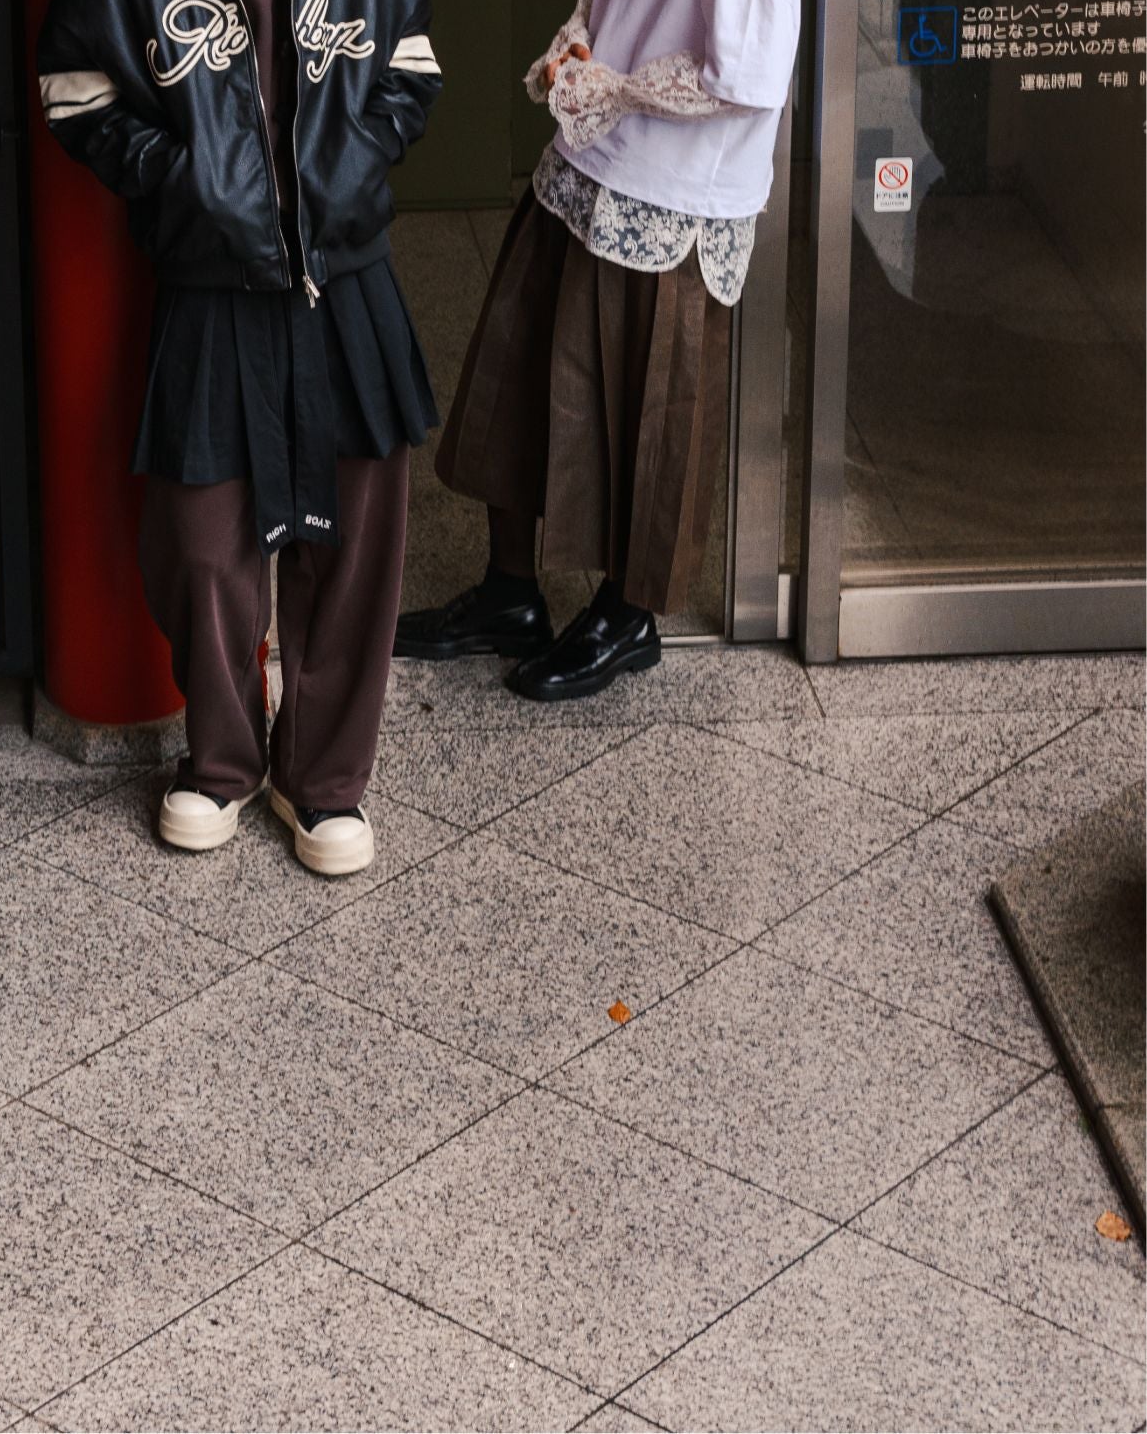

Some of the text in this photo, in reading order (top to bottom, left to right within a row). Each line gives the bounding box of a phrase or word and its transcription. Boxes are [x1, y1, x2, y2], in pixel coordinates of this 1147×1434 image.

[961, 20, 1101, 41] 専用となっています
[1020, 72, 1083, 91] 運転時間
[1097, 70, 1129, 88] 午前
